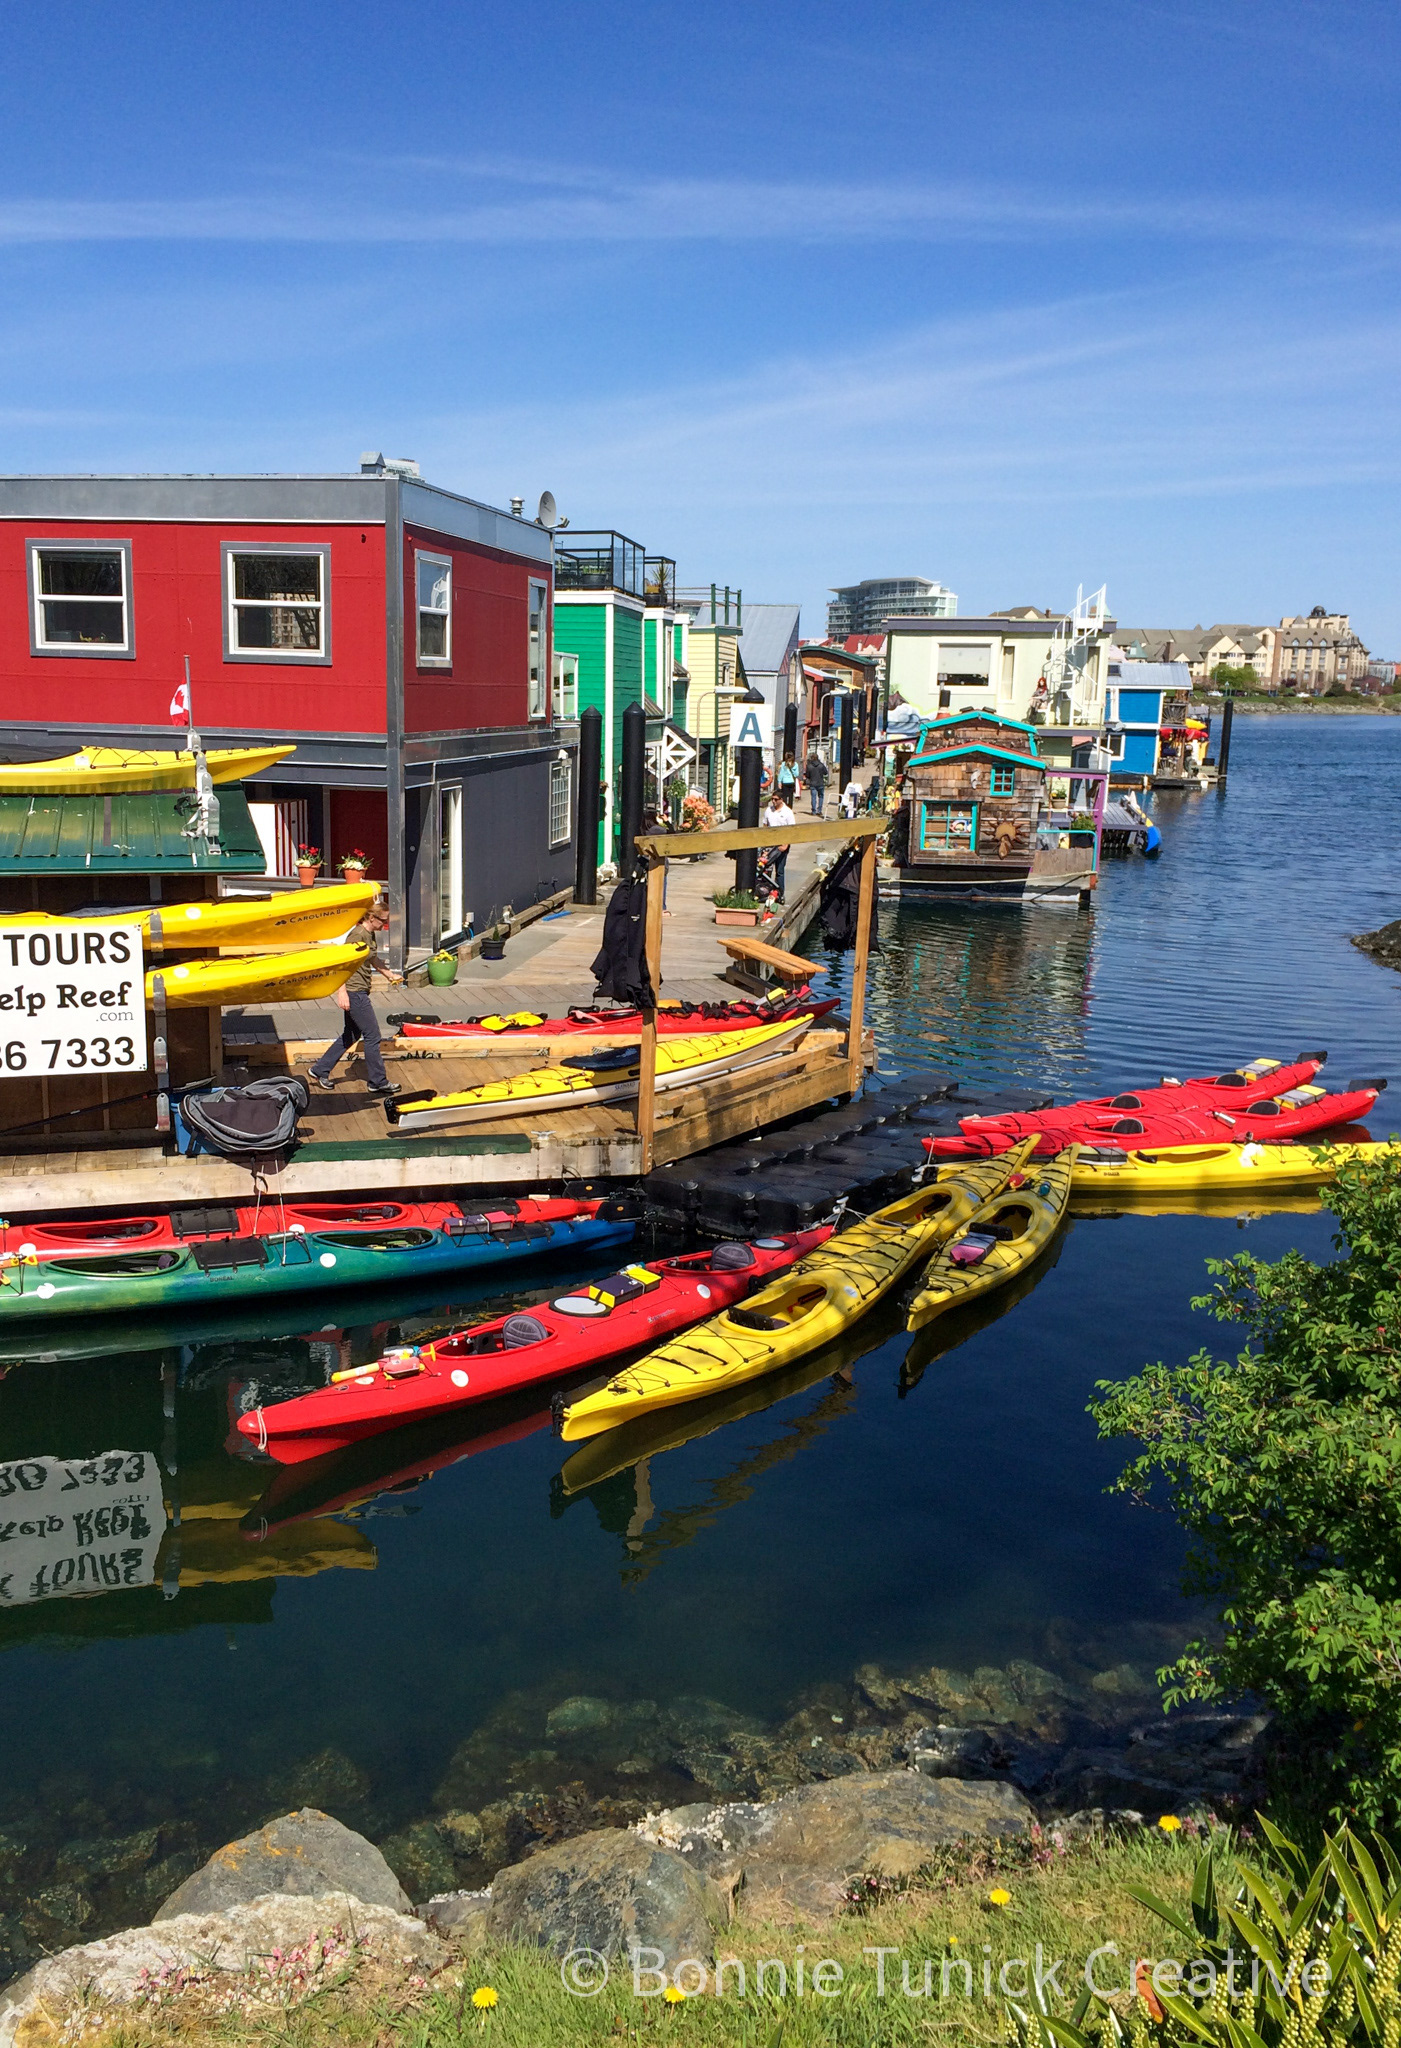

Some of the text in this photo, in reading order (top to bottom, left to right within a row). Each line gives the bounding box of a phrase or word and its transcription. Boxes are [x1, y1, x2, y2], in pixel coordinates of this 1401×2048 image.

[737, 712, 763, 743] A
[289, 910, 335, 924] CAROLINA
[2, 931, 131, 967] TOURS
[278, 973, 324, 986] CAROLINA
[56, 981, 133, 1009] Reef
[95, 1011, 134, 1022] .com
[41, 1036, 135, 1069] 7333
